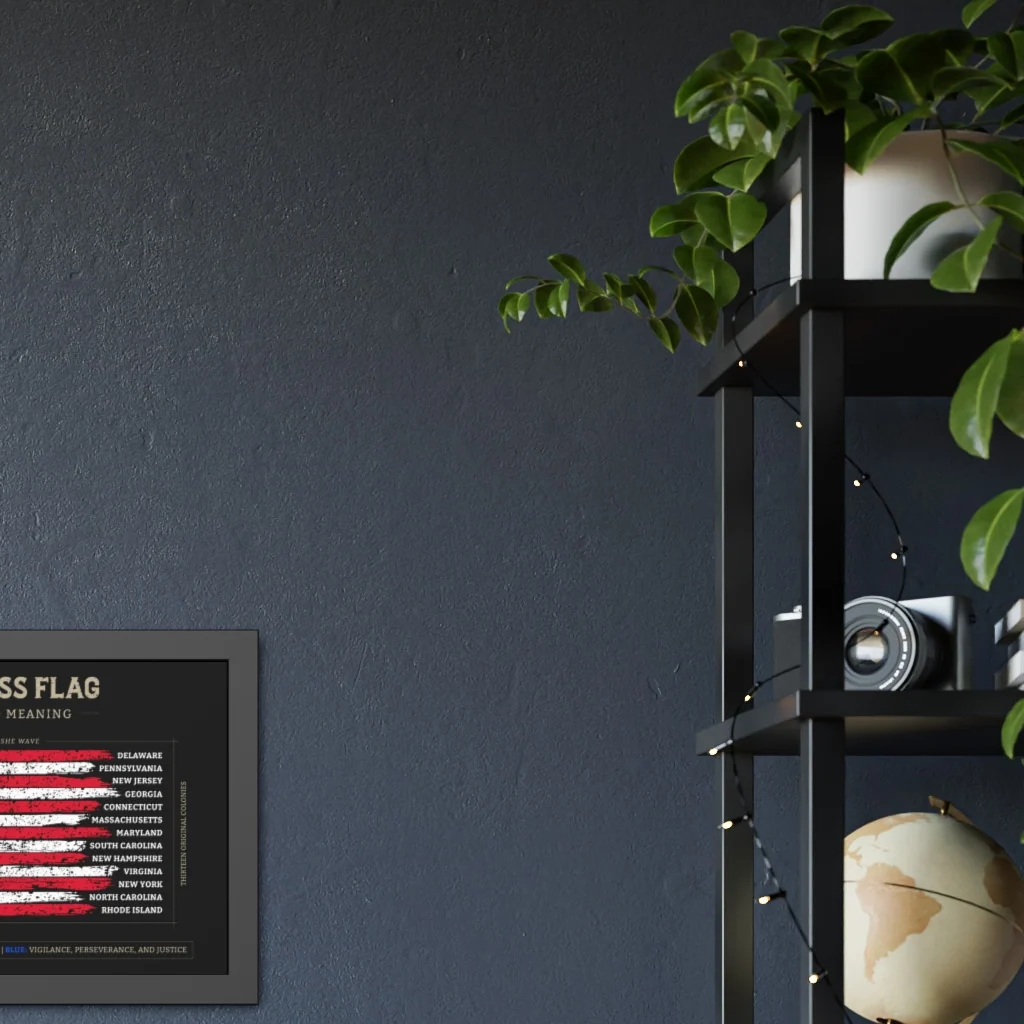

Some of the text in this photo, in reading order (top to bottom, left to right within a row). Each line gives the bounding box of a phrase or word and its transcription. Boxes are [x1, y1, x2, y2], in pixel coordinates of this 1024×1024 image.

[34, 676, 100, 699] FLAG
[6, 708, 72, 719] MEANING
[133, 777, 163, 785] JERSEY
[103, 803, 163, 811] CONNECTICUT
[91, 816, 163, 824] MASSACHUSETTS
[116, 829, 163, 837] MARYLAND
[89, 893, 163, 901] NORTH CAROLINA
[101, 906, 163, 914] RHODE ISLAND
[29, 946, 73, 954] VIGILANCE,
[75, 946, 136, 954] PERSEVERANCE,
[156, 946, 187, 954] JUSTICE
